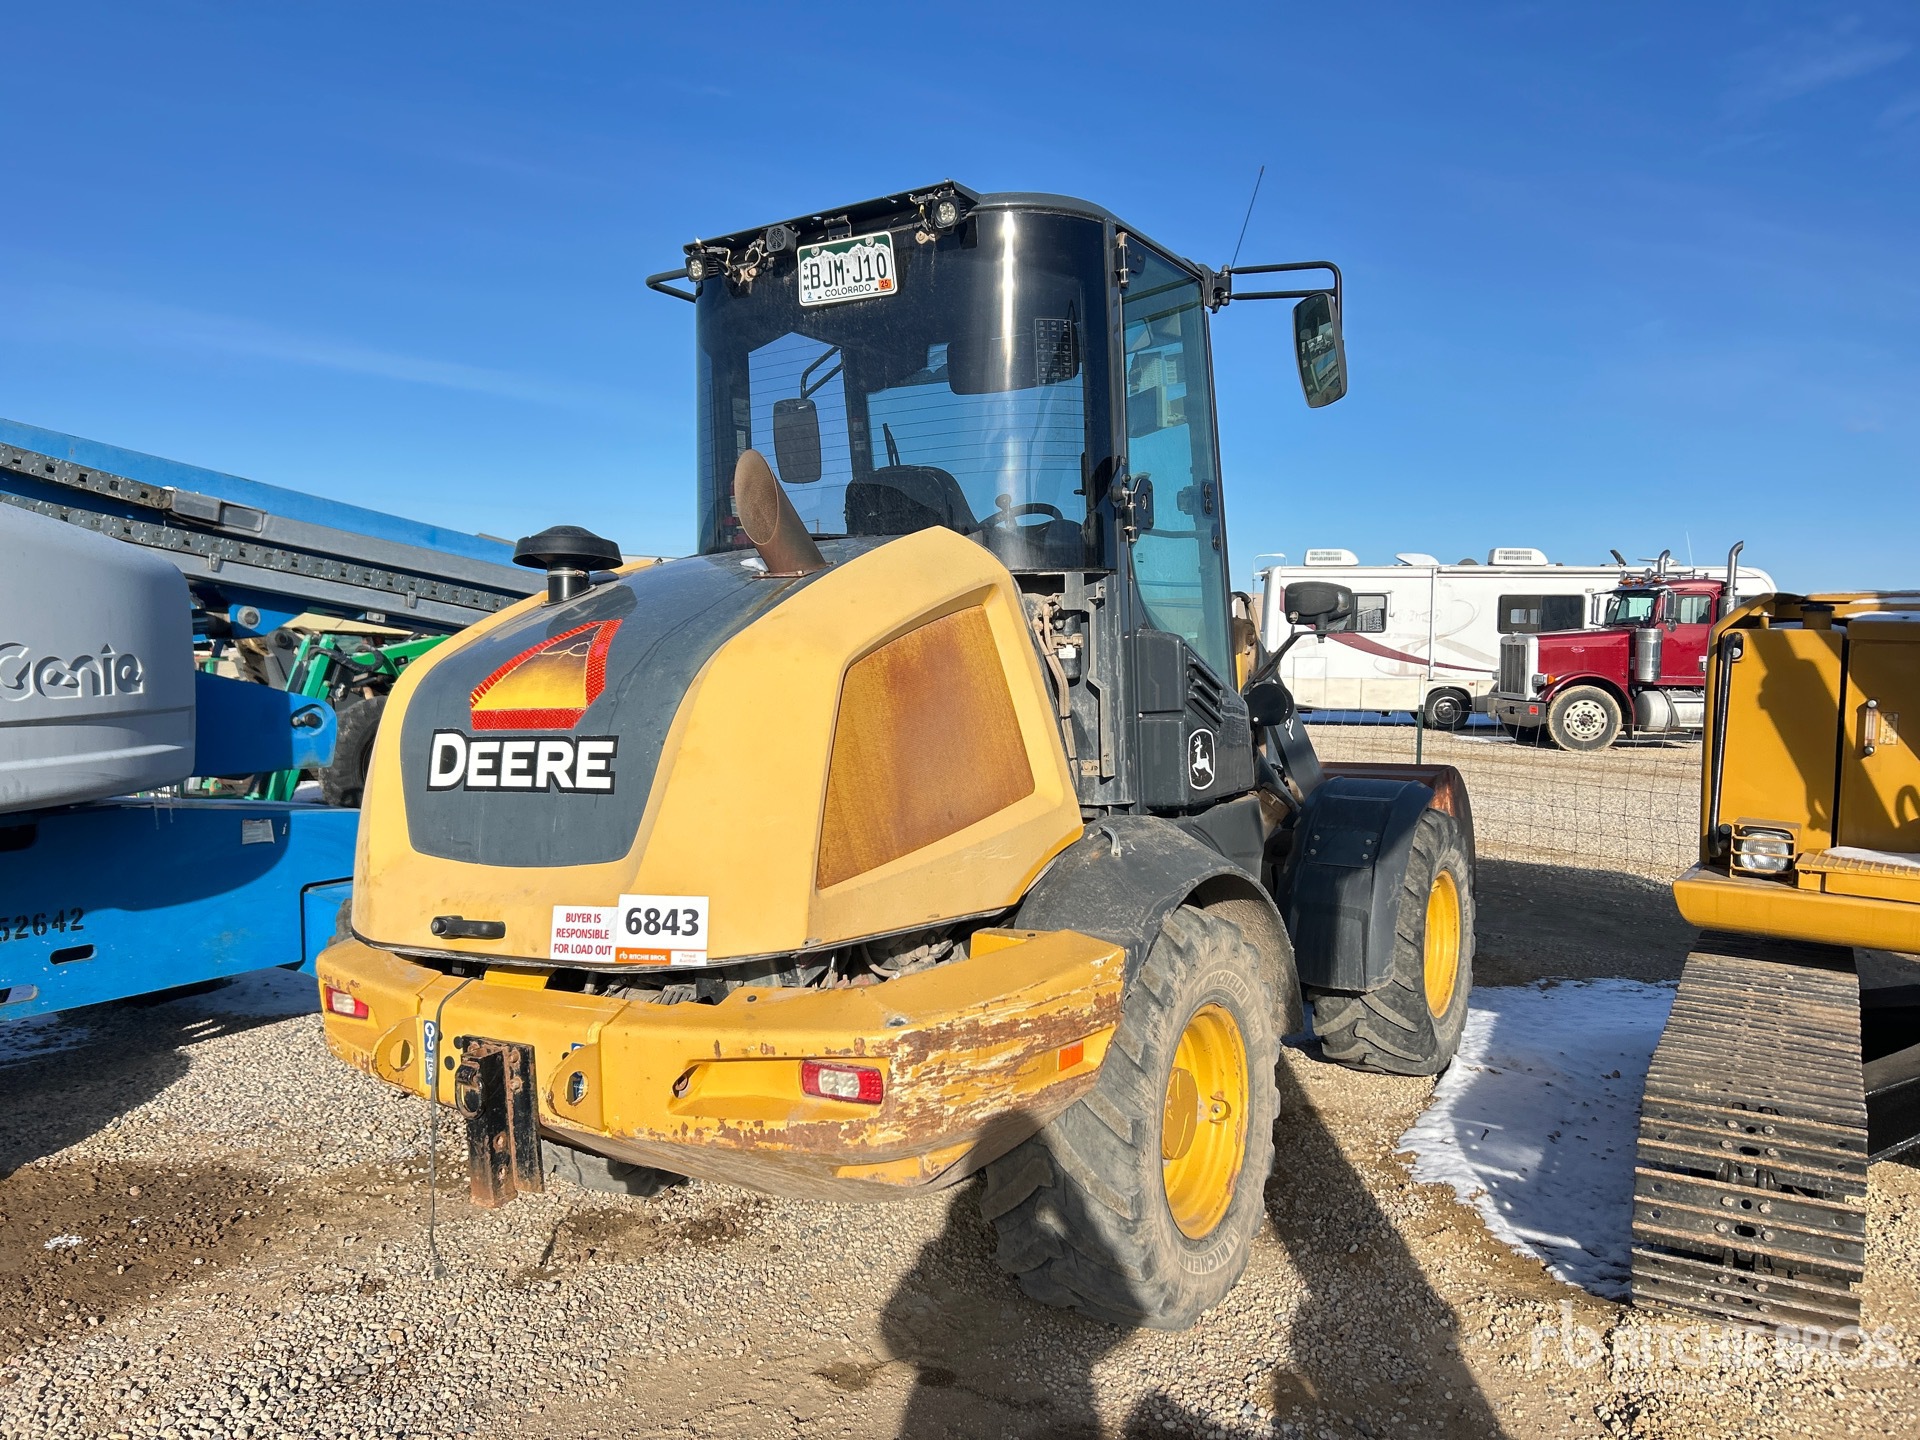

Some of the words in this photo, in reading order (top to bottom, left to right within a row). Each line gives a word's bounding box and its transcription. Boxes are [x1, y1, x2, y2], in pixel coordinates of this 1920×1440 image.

[824, 283, 872, 298] COLORADO
[880, 280, 889, 288] 25
[0, 642, 144, 702] Genie
[428, 733, 616, 790] DEERE
[565, 912, 592, 924] BUYER
[594, 913, 602, 924] IS
[625, 907, 700, 937] 6843
[556, 928, 610, 940] RESPONSIBLE
[553, 943, 569, 954] FOR
[571, 944, 593, 955] LOAD
[594, 945, 613, 956] OUT
[628, 953, 650, 961] RITCHIE
